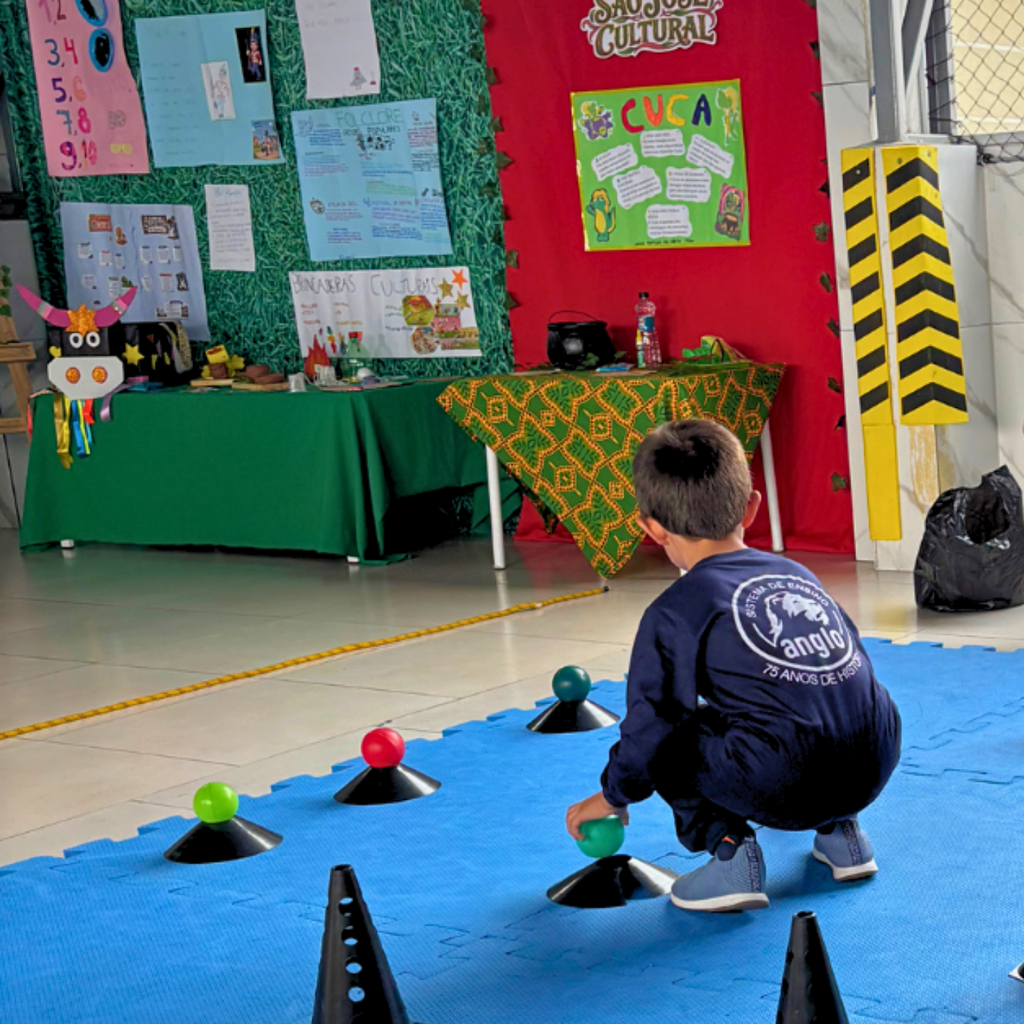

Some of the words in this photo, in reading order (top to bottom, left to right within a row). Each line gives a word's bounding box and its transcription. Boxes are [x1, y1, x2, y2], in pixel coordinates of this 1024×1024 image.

[595, 14, 714, 56] CULTURAL
[621, 93, 712, 134] CUCA
[767, 581, 786, 590] DE
[780, 627, 845, 659] anglo
[763, 663, 779, 678] 75
[780, 669, 819, 686] ANOS
[821, 673, 839, 686] DE
